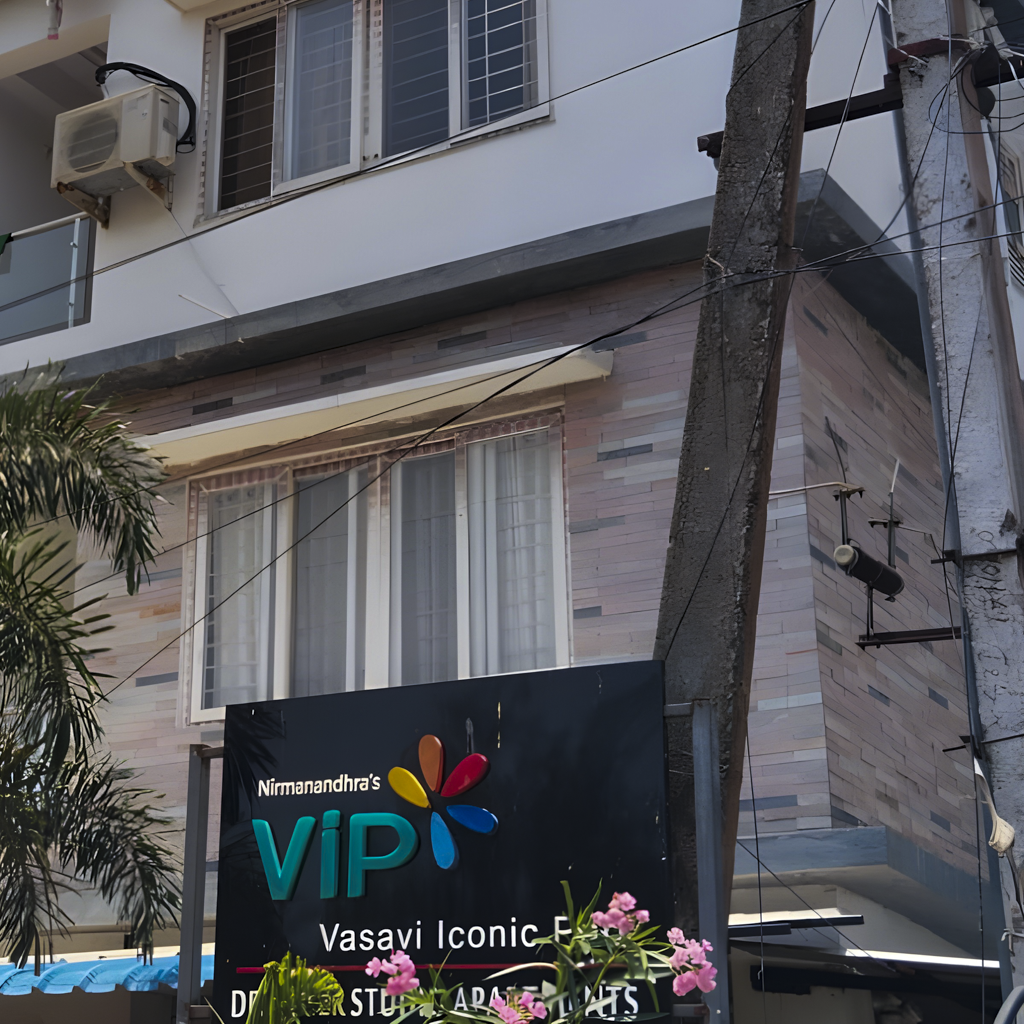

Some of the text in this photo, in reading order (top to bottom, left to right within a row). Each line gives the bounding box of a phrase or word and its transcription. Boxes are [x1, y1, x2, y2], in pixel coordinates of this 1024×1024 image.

[257, 773, 381, 797] Nirmanandhra's
[319, 920, 422, 952] Vasavi
[438, 916, 539, 950] Iconic
